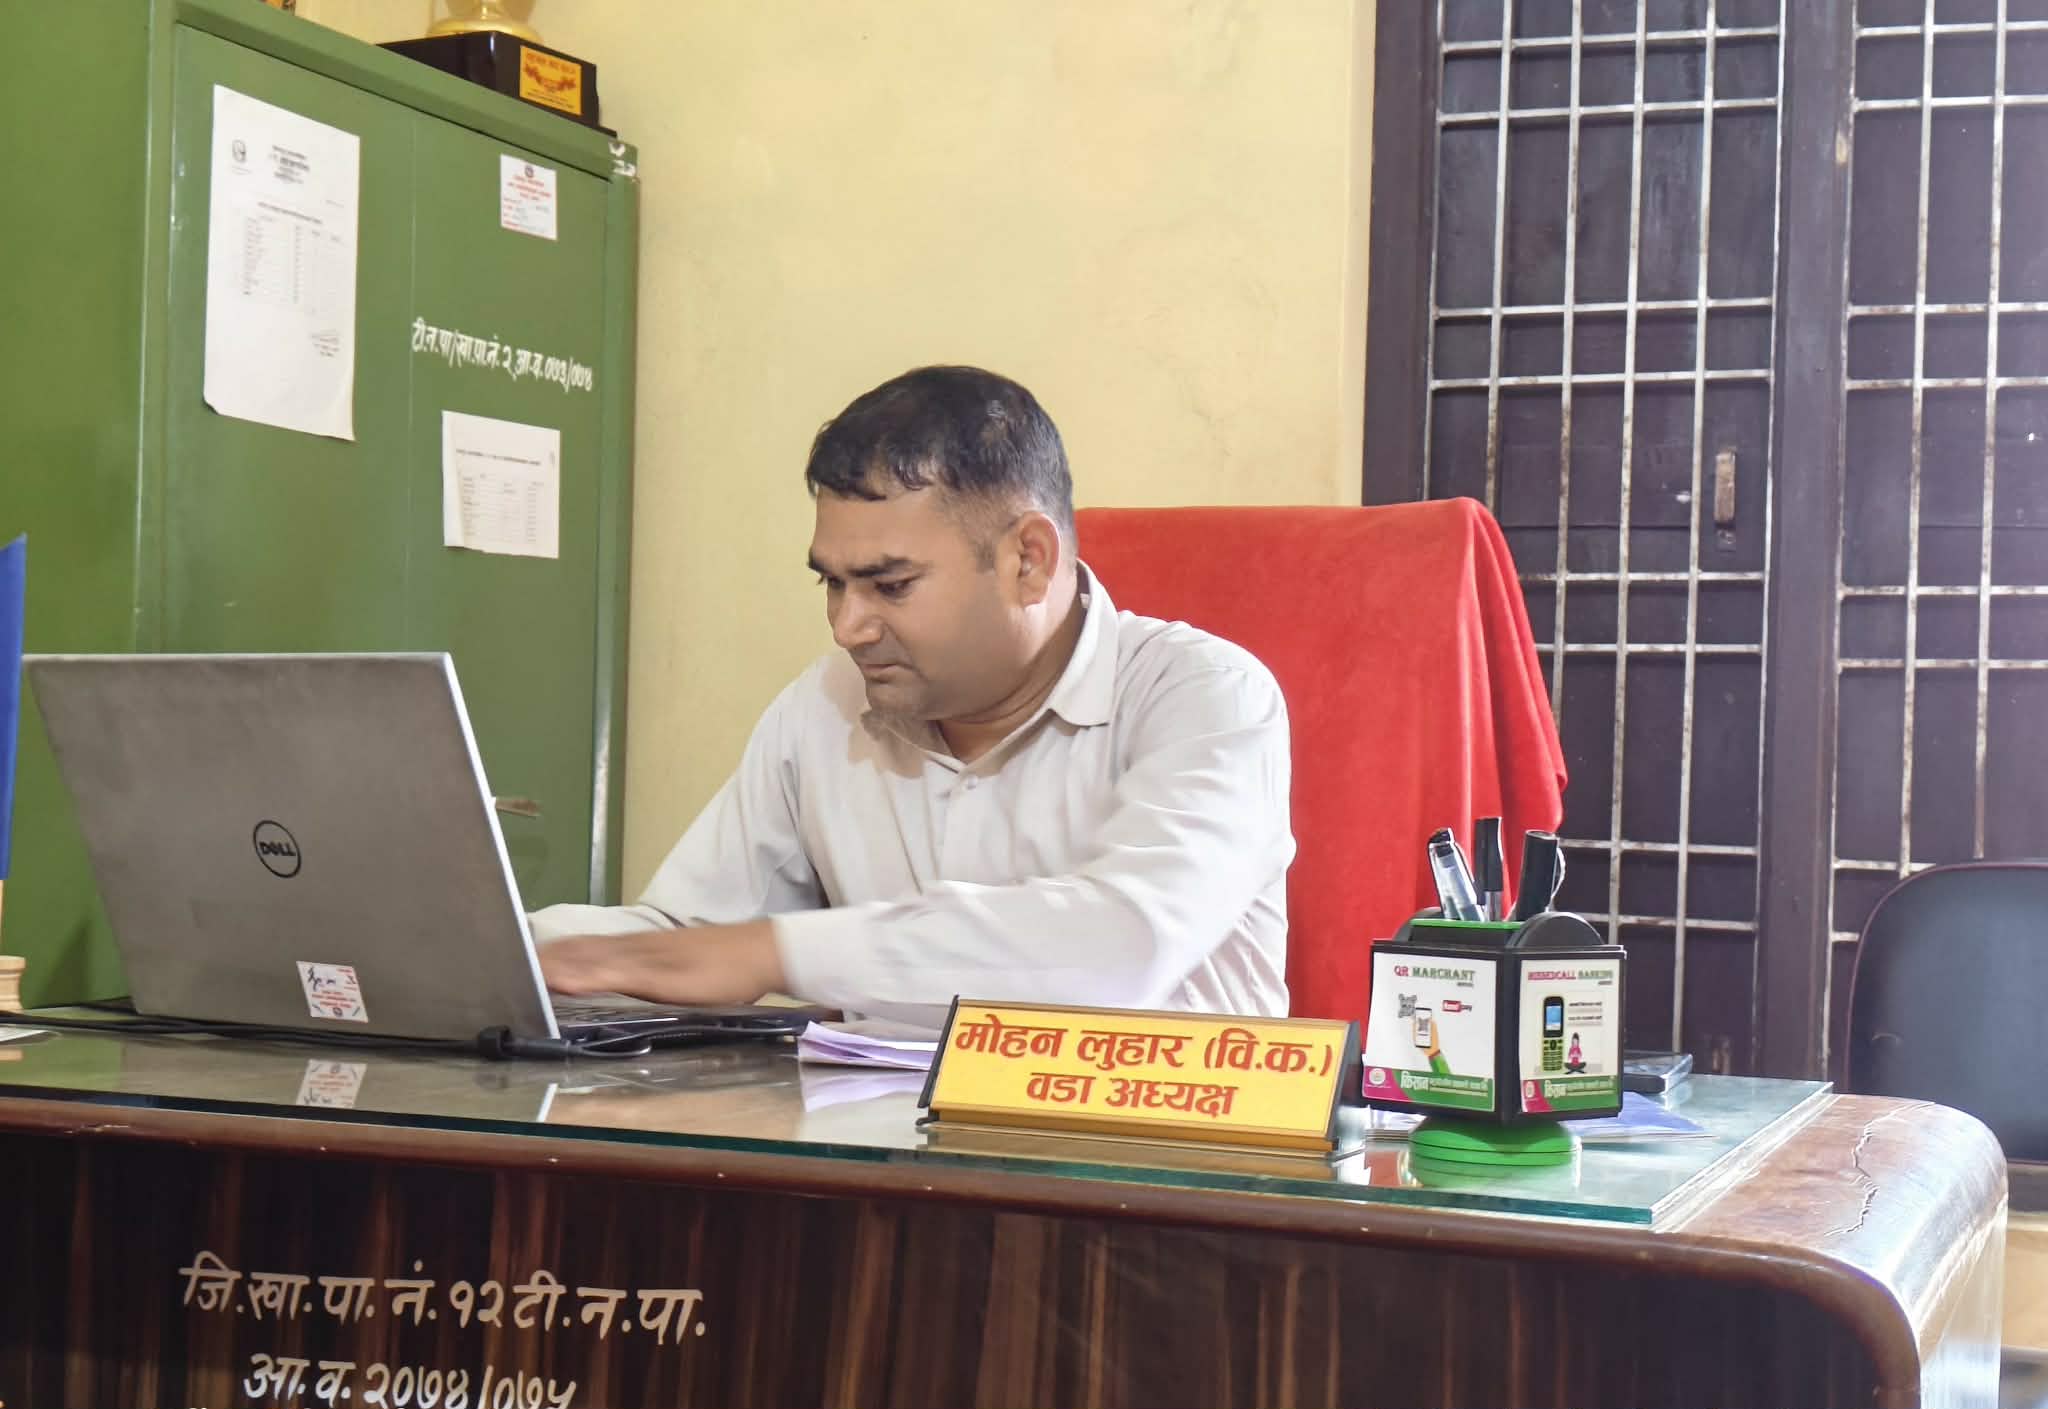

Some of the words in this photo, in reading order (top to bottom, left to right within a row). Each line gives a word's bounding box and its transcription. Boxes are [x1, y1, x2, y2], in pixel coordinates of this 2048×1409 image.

[259, 841, 297, 857] DELL
[1394, 965, 1409, 977] QR
[955, 1014, 1068, 1059] मोहन
[1076, 1030, 1193, 1071] लुहार
[1203, 1028, 1334, 1078] (वि.क.)
[1025, 1072, 1097, 1105] वडा
[1105, 1077, 1239, 1118] अध्यक्ष
